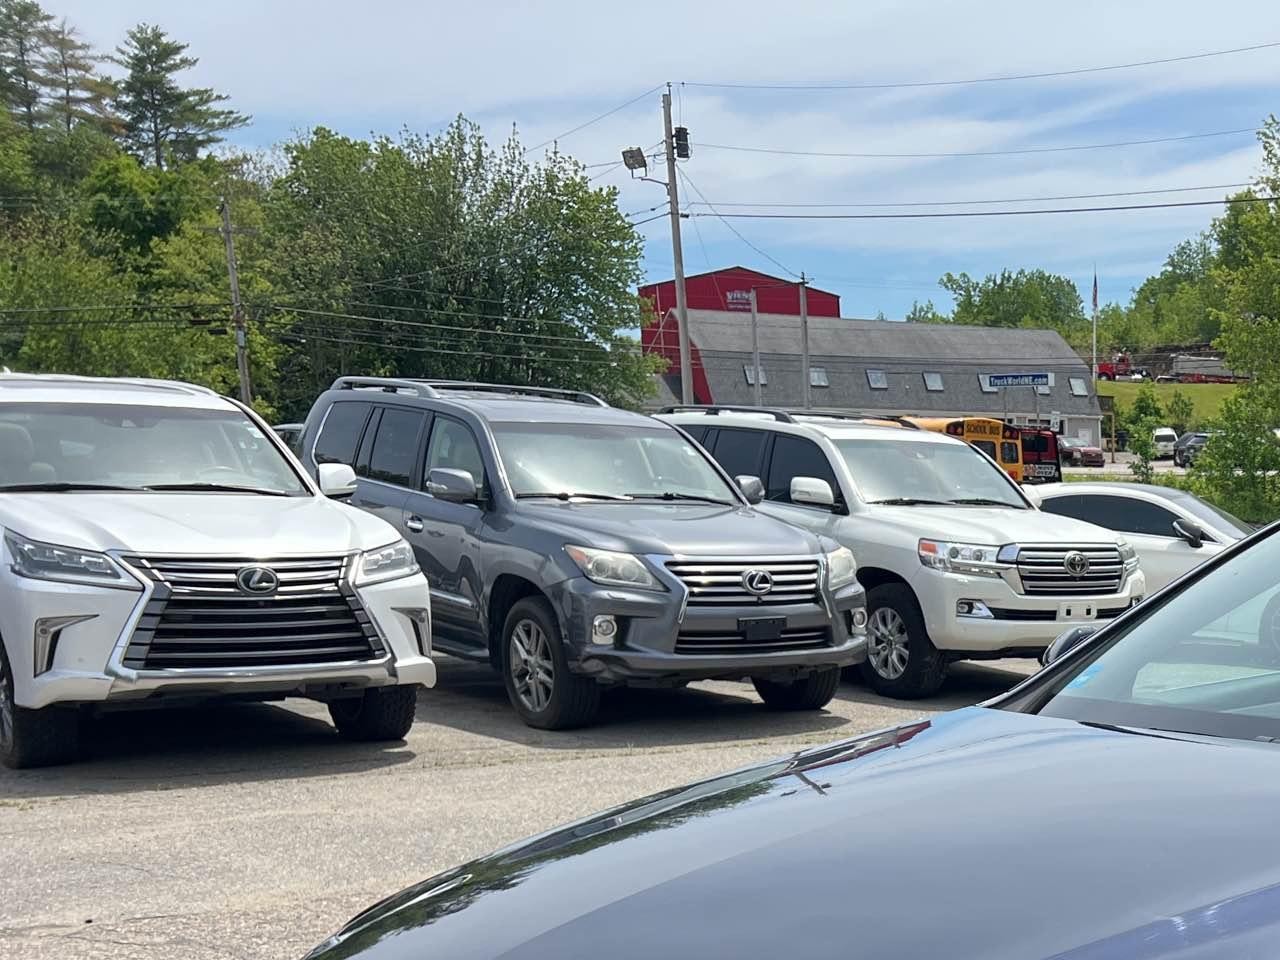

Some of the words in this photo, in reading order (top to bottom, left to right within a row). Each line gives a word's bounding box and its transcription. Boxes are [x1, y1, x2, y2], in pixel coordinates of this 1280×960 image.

[991, 376, 1048, 386] TruckWorldNE.com
[967, 424, 987, 434] SCHOOL
[990, 425, 1000, 435] BUS
